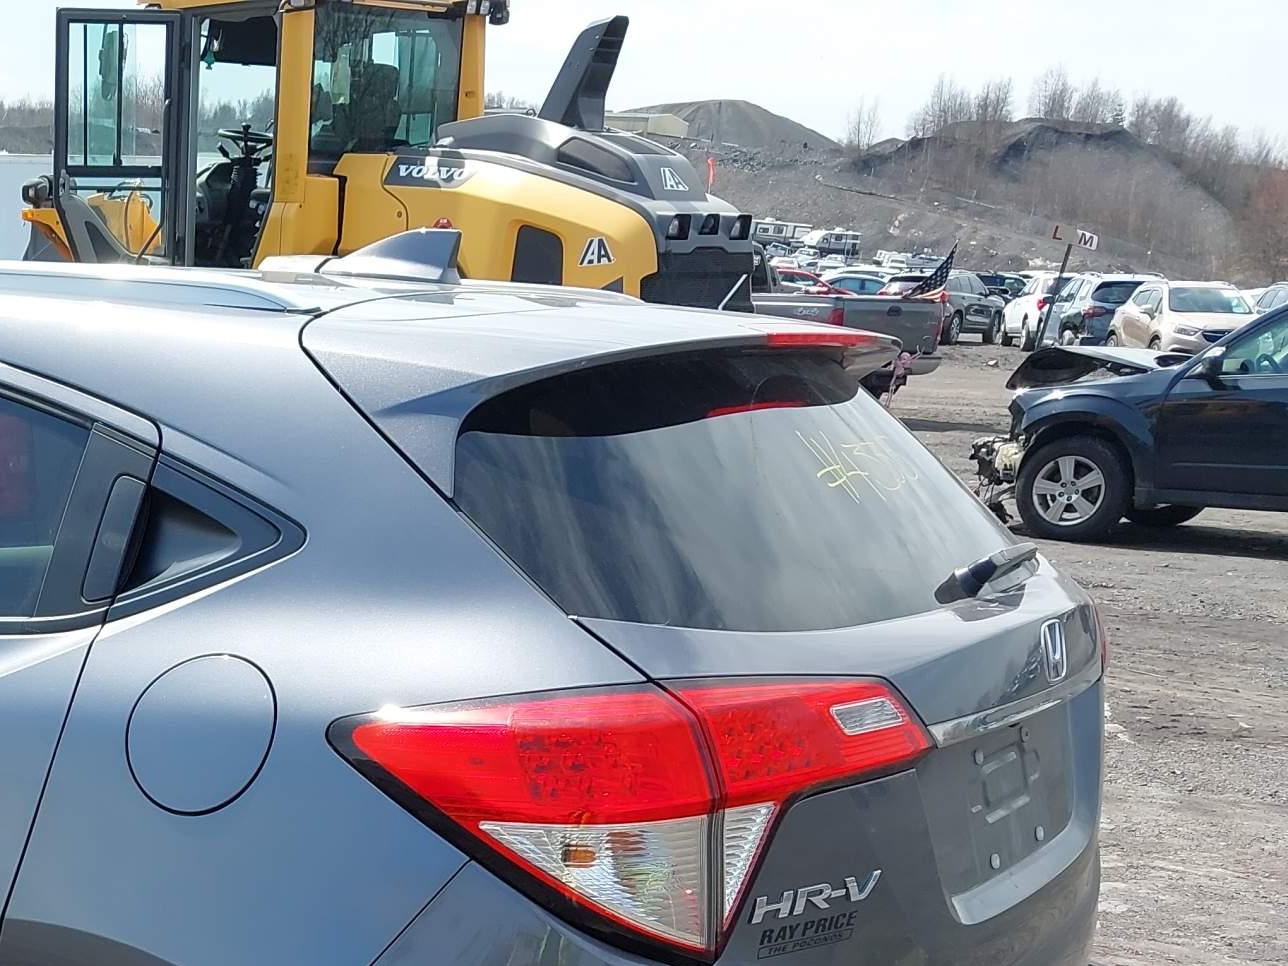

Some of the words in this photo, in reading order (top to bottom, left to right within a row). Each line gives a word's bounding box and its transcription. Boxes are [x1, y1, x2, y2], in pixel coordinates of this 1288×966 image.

[398, 164, 467, 180] VOLVO
[1052, 225, 1063, 241] L
[1078, 232, 1095, 248] M
[748, 869, 882, 925] HR-V
[759, 921, 801, 946] RAY
[801, 910, 858, 938] PRICE
[767, 943, 788, 955] THE
